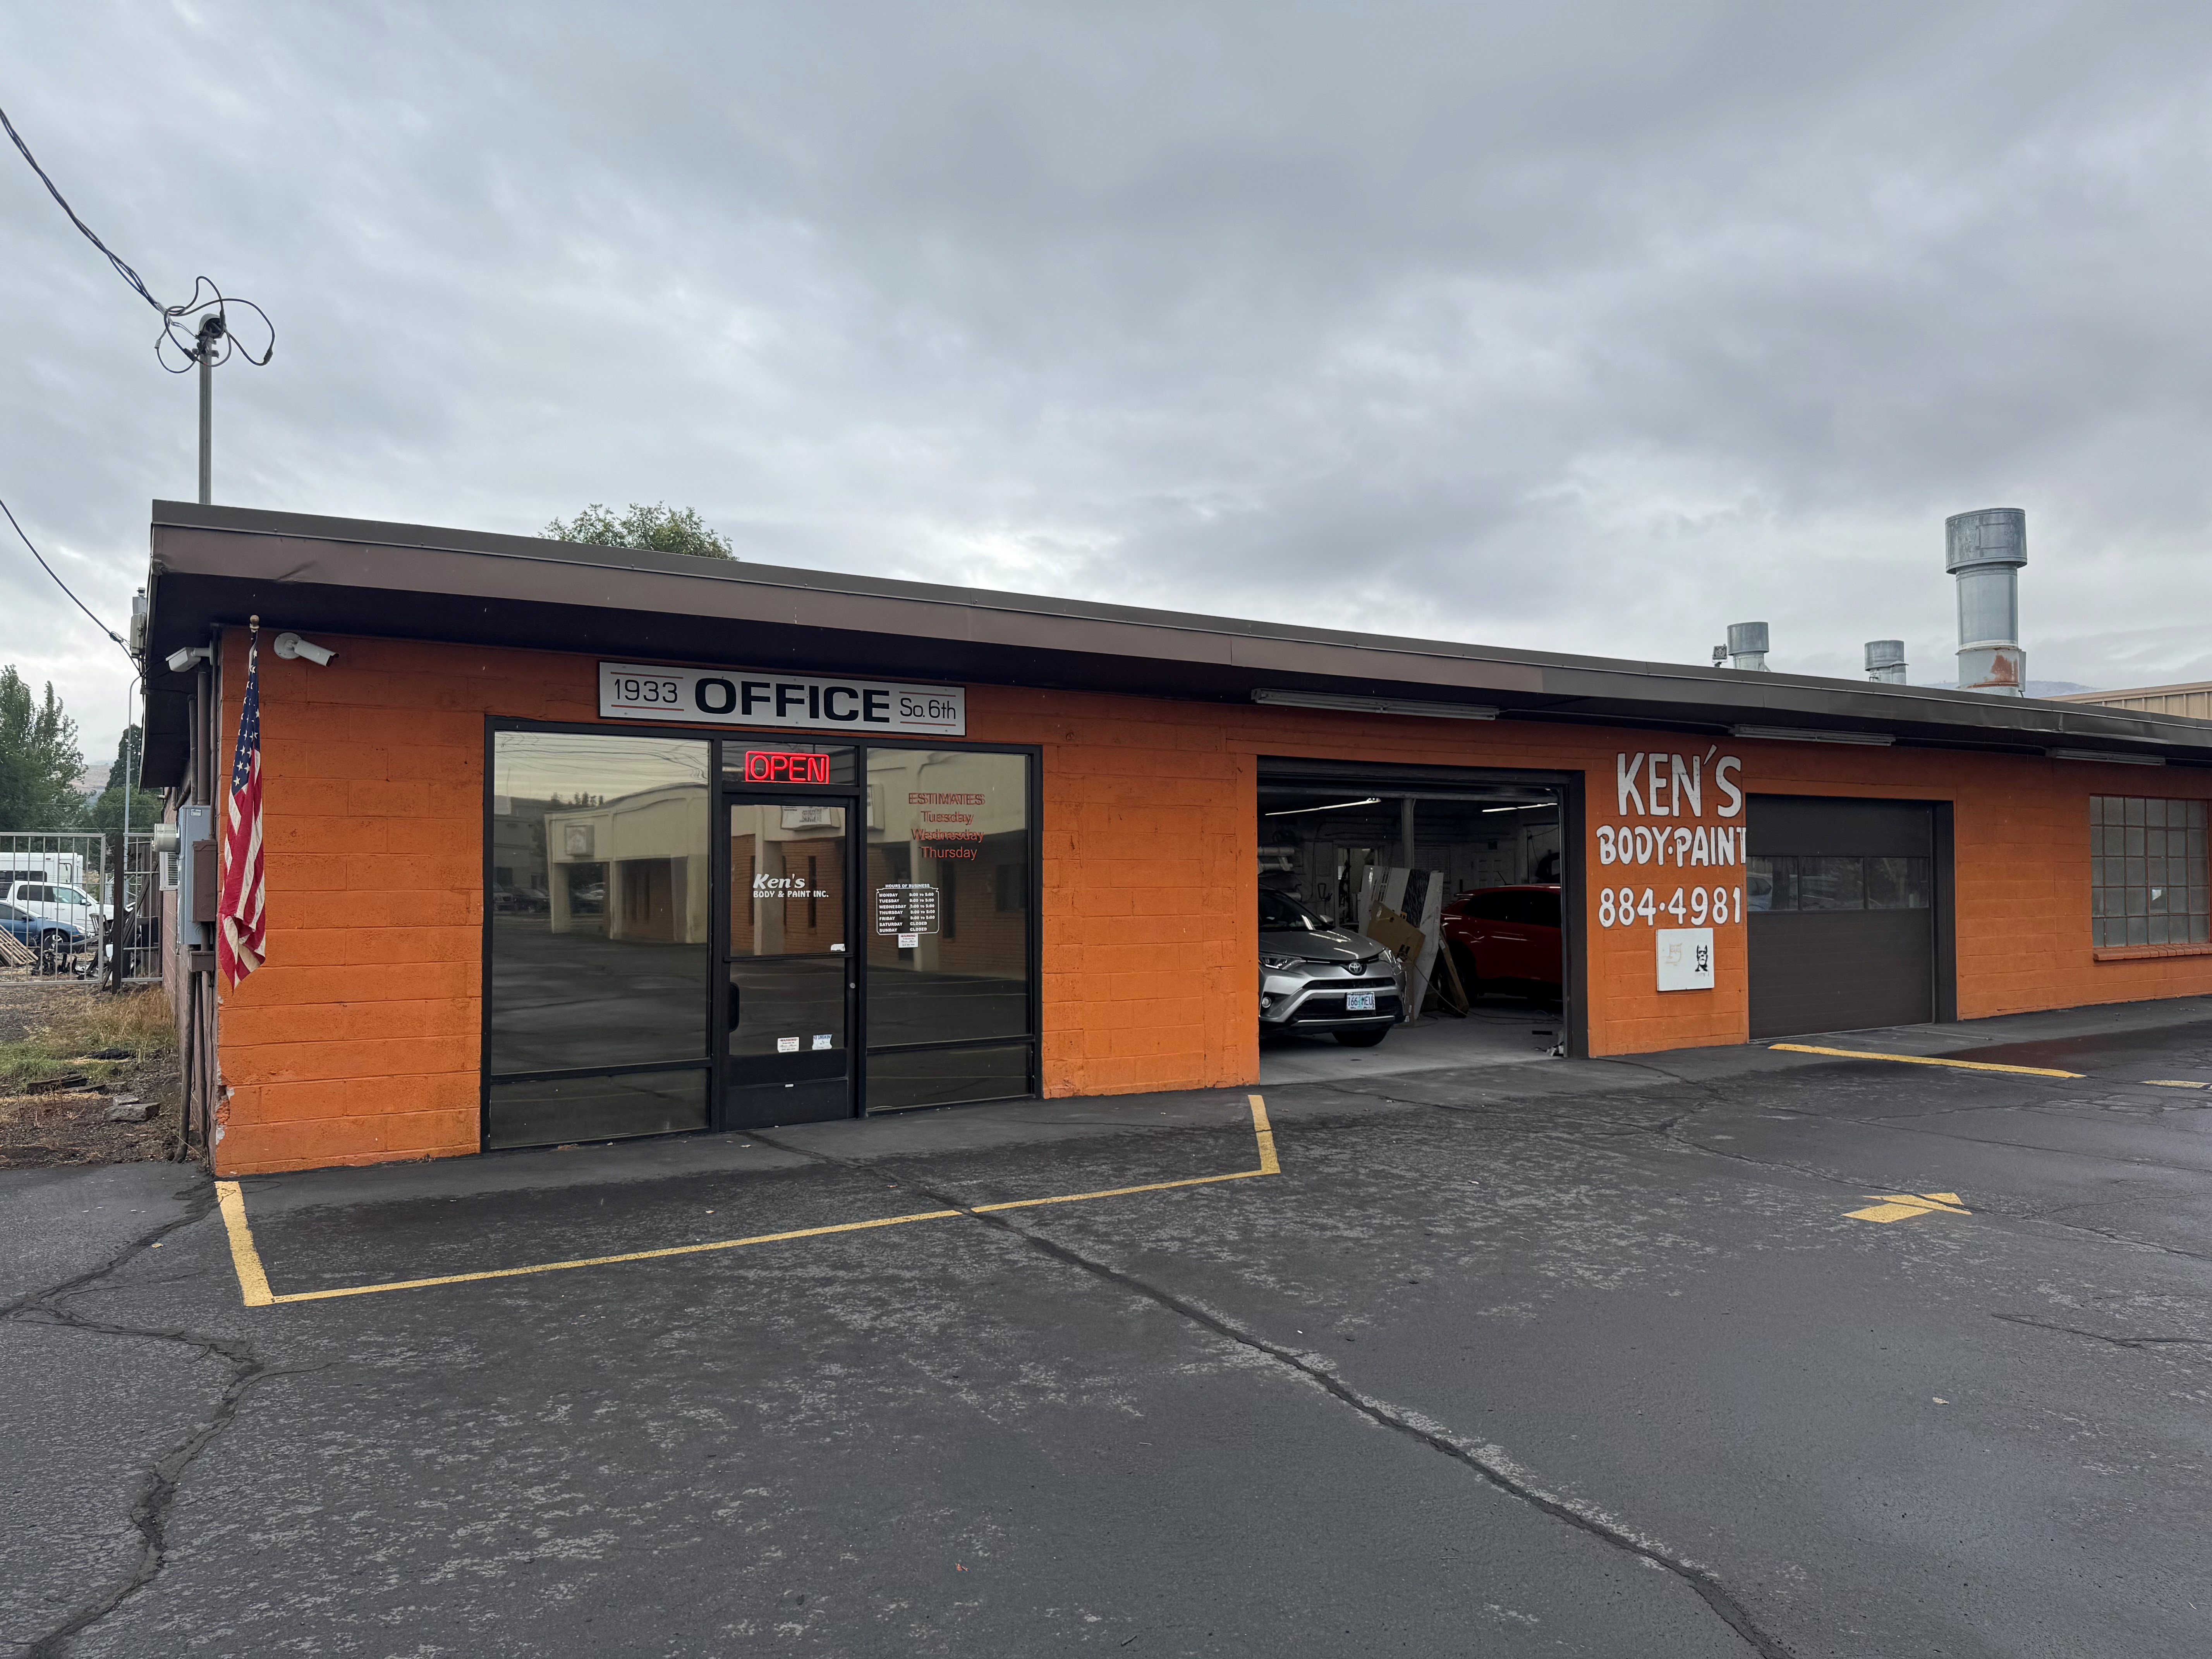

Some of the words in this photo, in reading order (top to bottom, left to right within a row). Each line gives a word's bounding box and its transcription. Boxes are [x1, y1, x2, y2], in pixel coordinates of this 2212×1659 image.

[614, 678, 678, 703] 1933
[695, 677, 890, 723] OFFICE
[900, 697, 925, 717] So.
[929, 700, 956, 719] 6th
[750, 755, 825, 782] OPEN
[1617, 744, 1742, 817] KEN'S
[908, 793, 986, 805] ESTIMATES
[921, 811, 974, 826] Tuesday
[911, 828, 984, 843] Wednesday
[919, 846, 977, 860] Thursday
[753, 873, 805, 890] Ken's
[1348, 997, 1358, 1006] 166
[1362, 996, 1373, 1006] MEU
